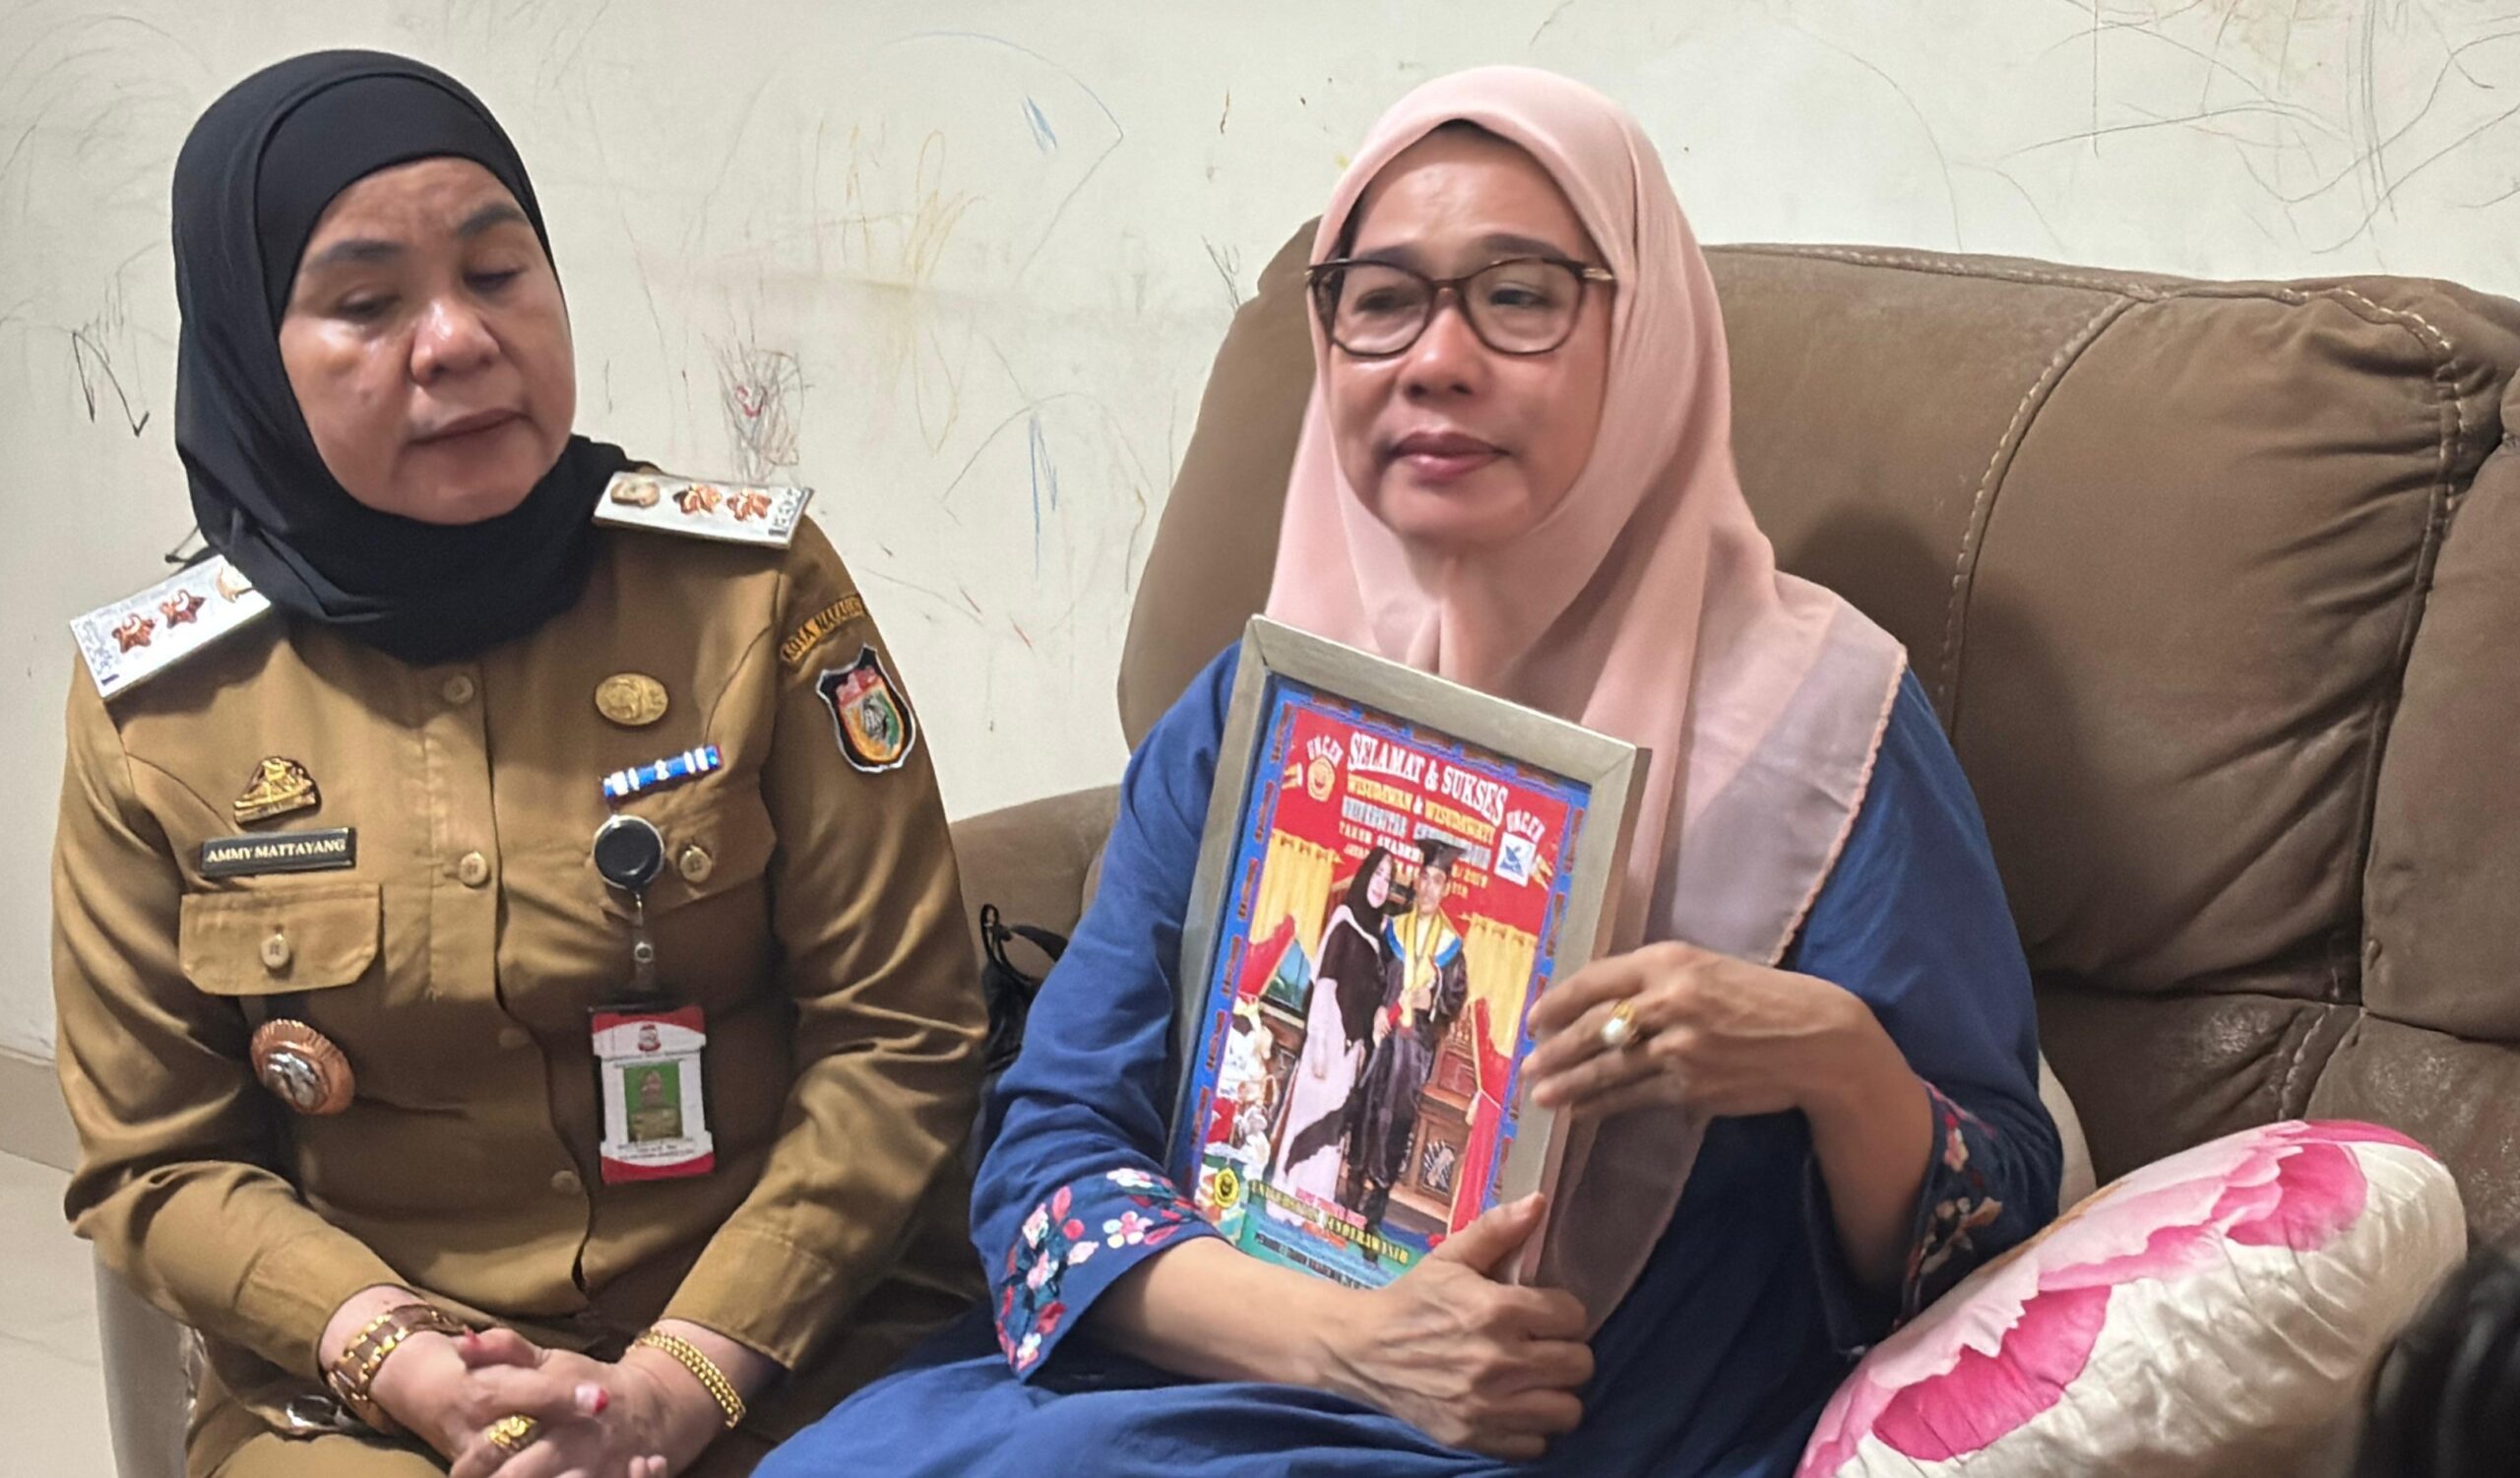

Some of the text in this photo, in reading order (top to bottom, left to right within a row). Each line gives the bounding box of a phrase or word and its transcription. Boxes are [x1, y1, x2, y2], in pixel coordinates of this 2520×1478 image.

[1347, 732, 1509, 827] SELAMAT & SUKSES
[206, 838, 346, 863] AMMY MATTAYANG
